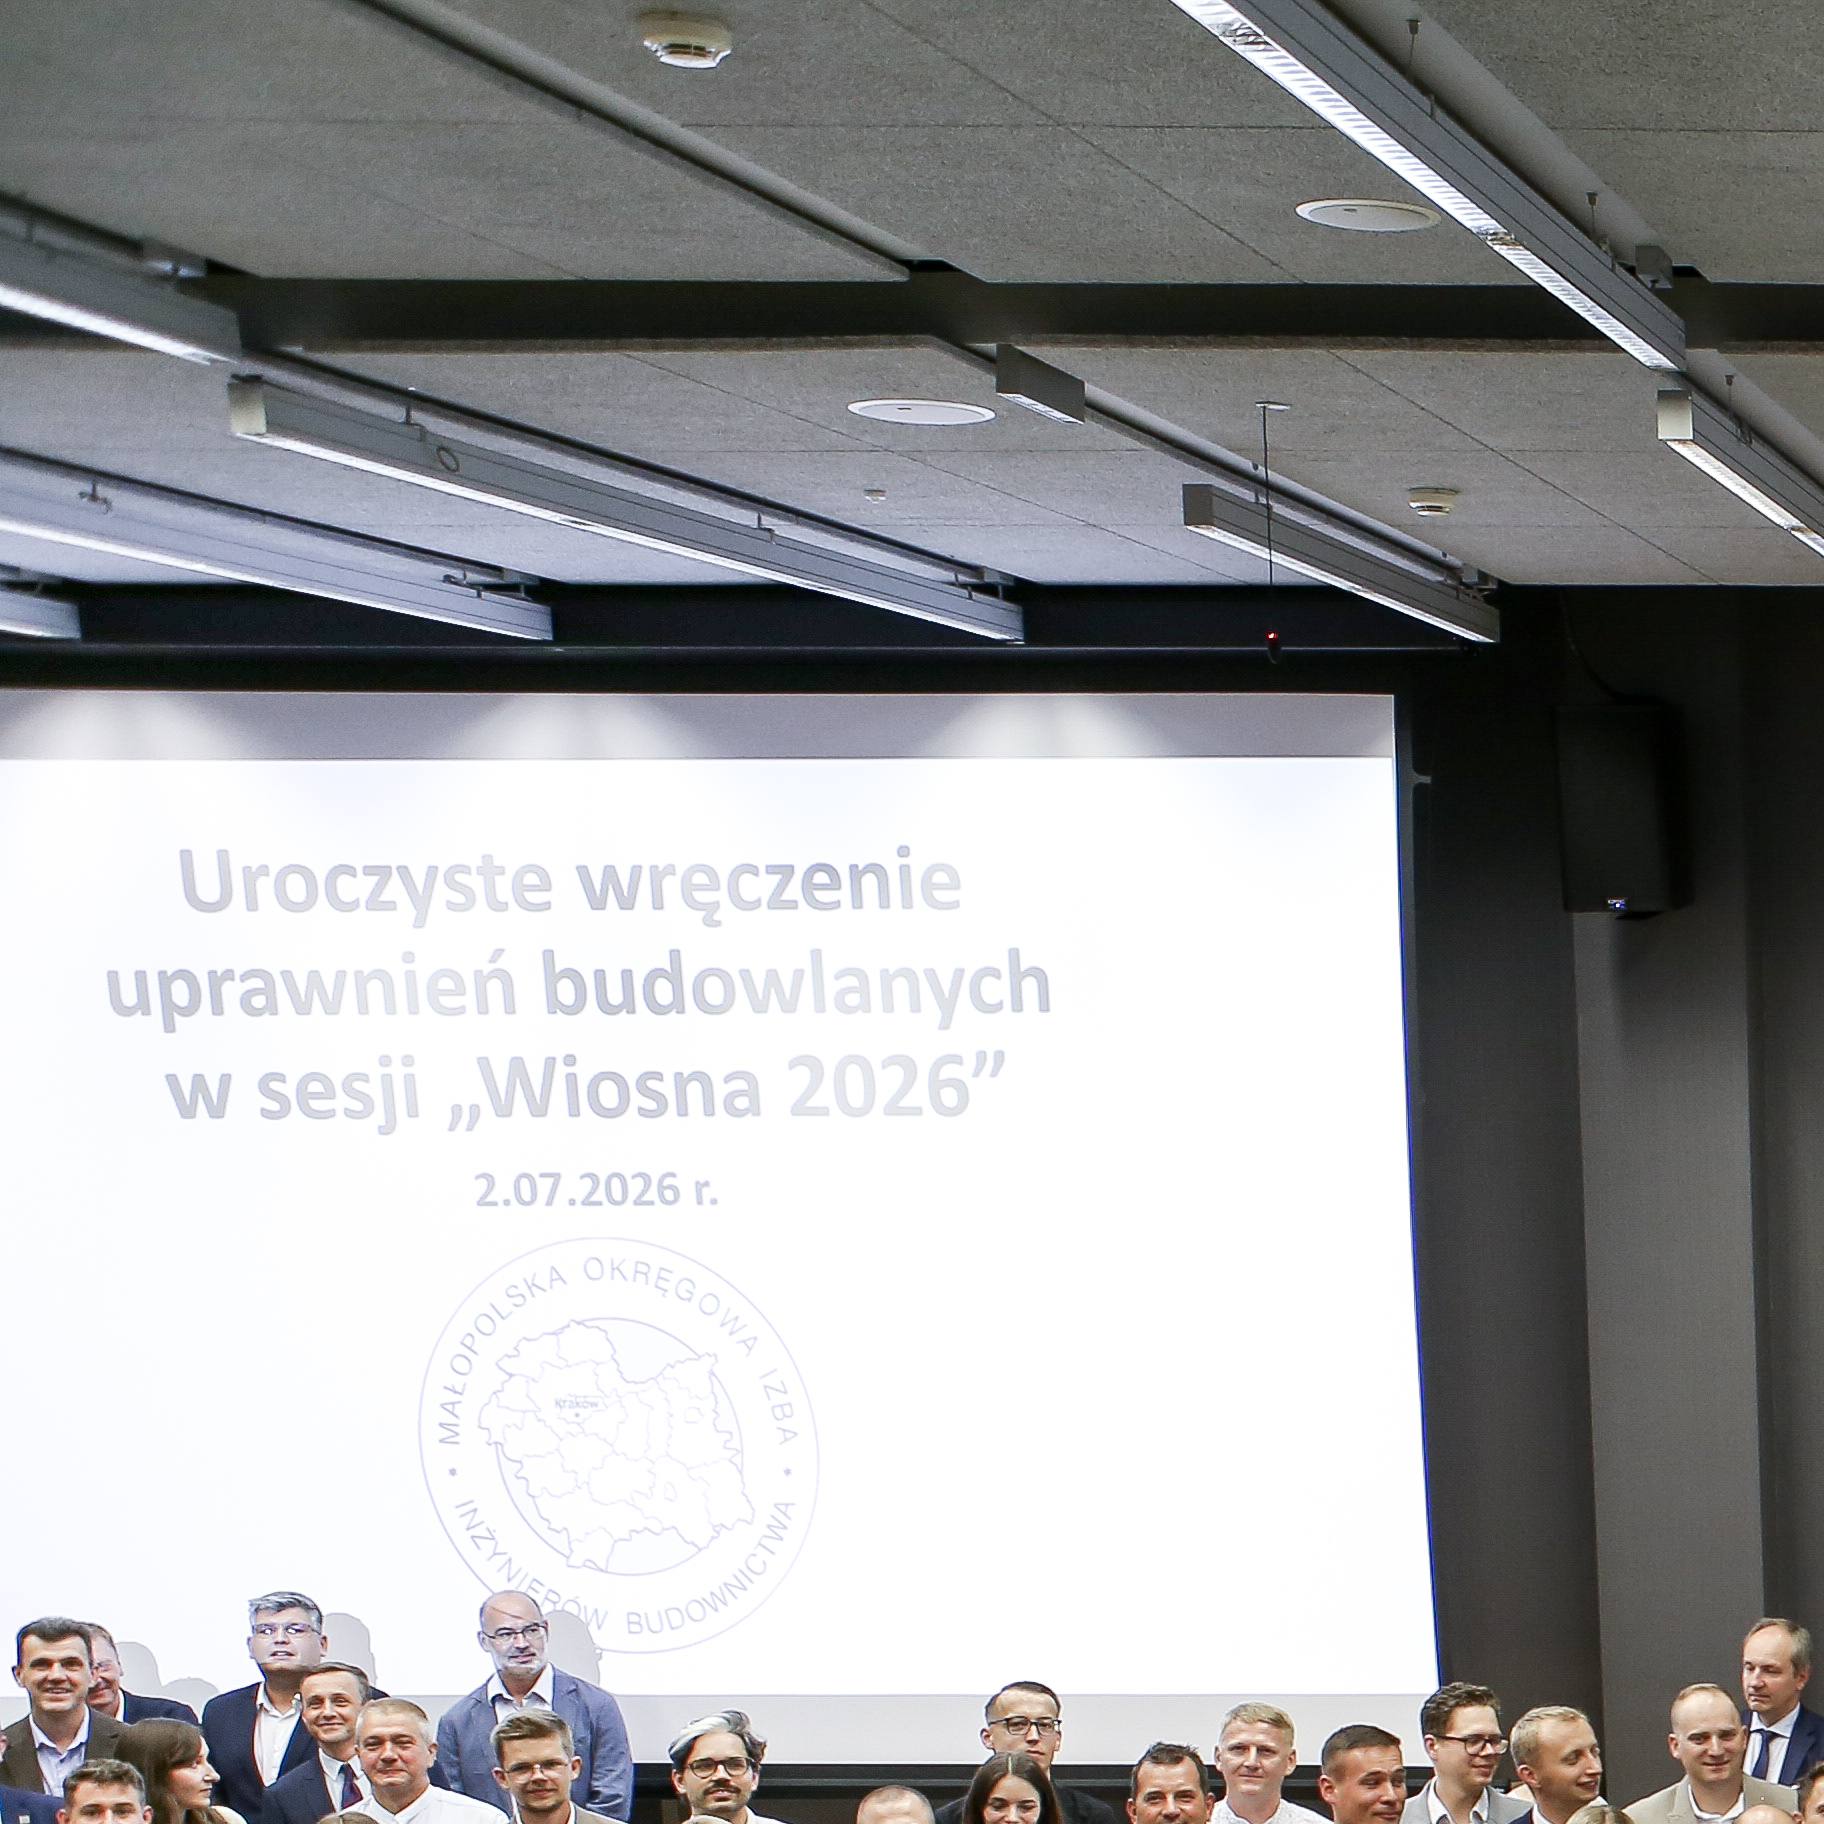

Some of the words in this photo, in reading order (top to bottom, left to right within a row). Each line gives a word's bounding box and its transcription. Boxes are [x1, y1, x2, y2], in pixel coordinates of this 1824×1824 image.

[179, 849, 552, 928] Uroczyste
[576, 845, 961, 927] wręczenie
[107, 947, 516, 1033] uprawnień
[542, 947, 1050, 1030] budowlanych
[165, 1072, 232, 1119] w
[257, 1054, 419, 1135] sesji
[447, 1054, 761, 1132] „Wiosna
[787, 1050, 1006, 1118] 2026”
[474, 1171, 681, 1207] 2.07.2026
[694, 1178, 718, 1206] r.
[438, 1265, 567, 1445] MAŁOPOLSKA
[584, 1256, 758, 1357] OKRĘGOWA
[759, 1368, 798, 1445] IZBA
[627, 1501, 796, 1635] BUDOWNICTWA
